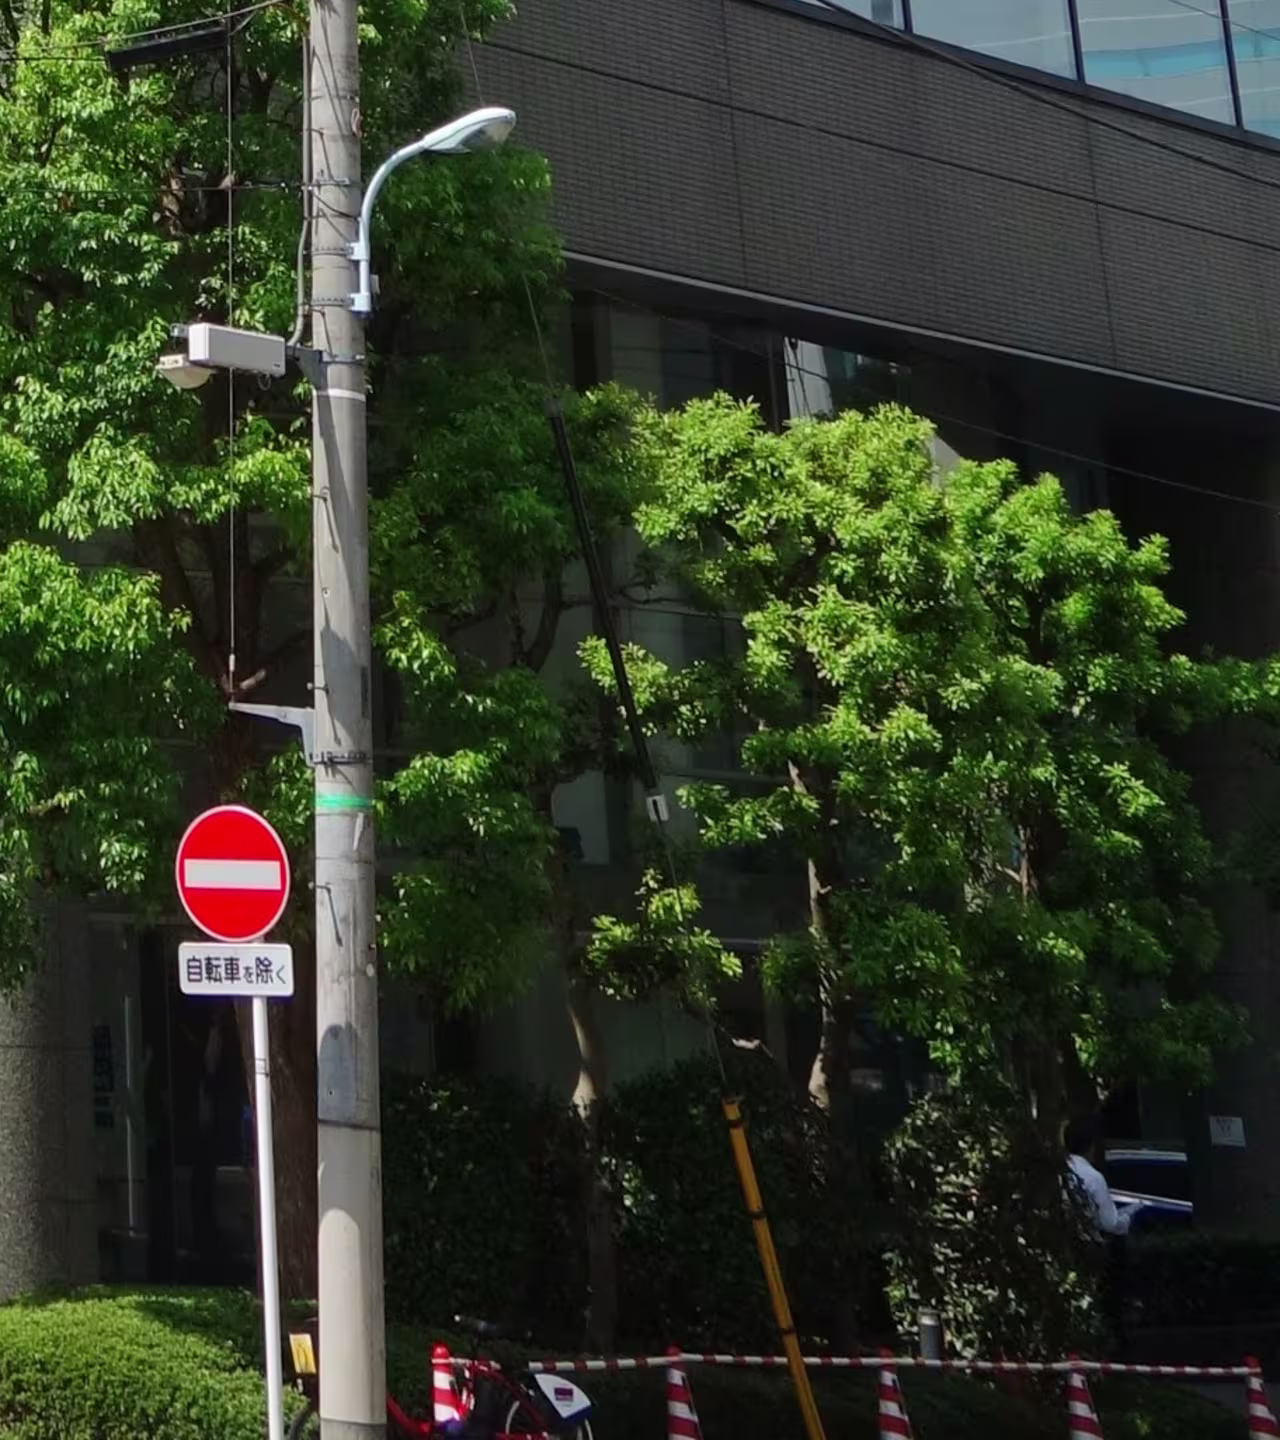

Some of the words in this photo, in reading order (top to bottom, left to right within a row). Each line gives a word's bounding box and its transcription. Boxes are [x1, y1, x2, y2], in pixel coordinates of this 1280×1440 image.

[187, 955, 286, 985] 自転車を除く
